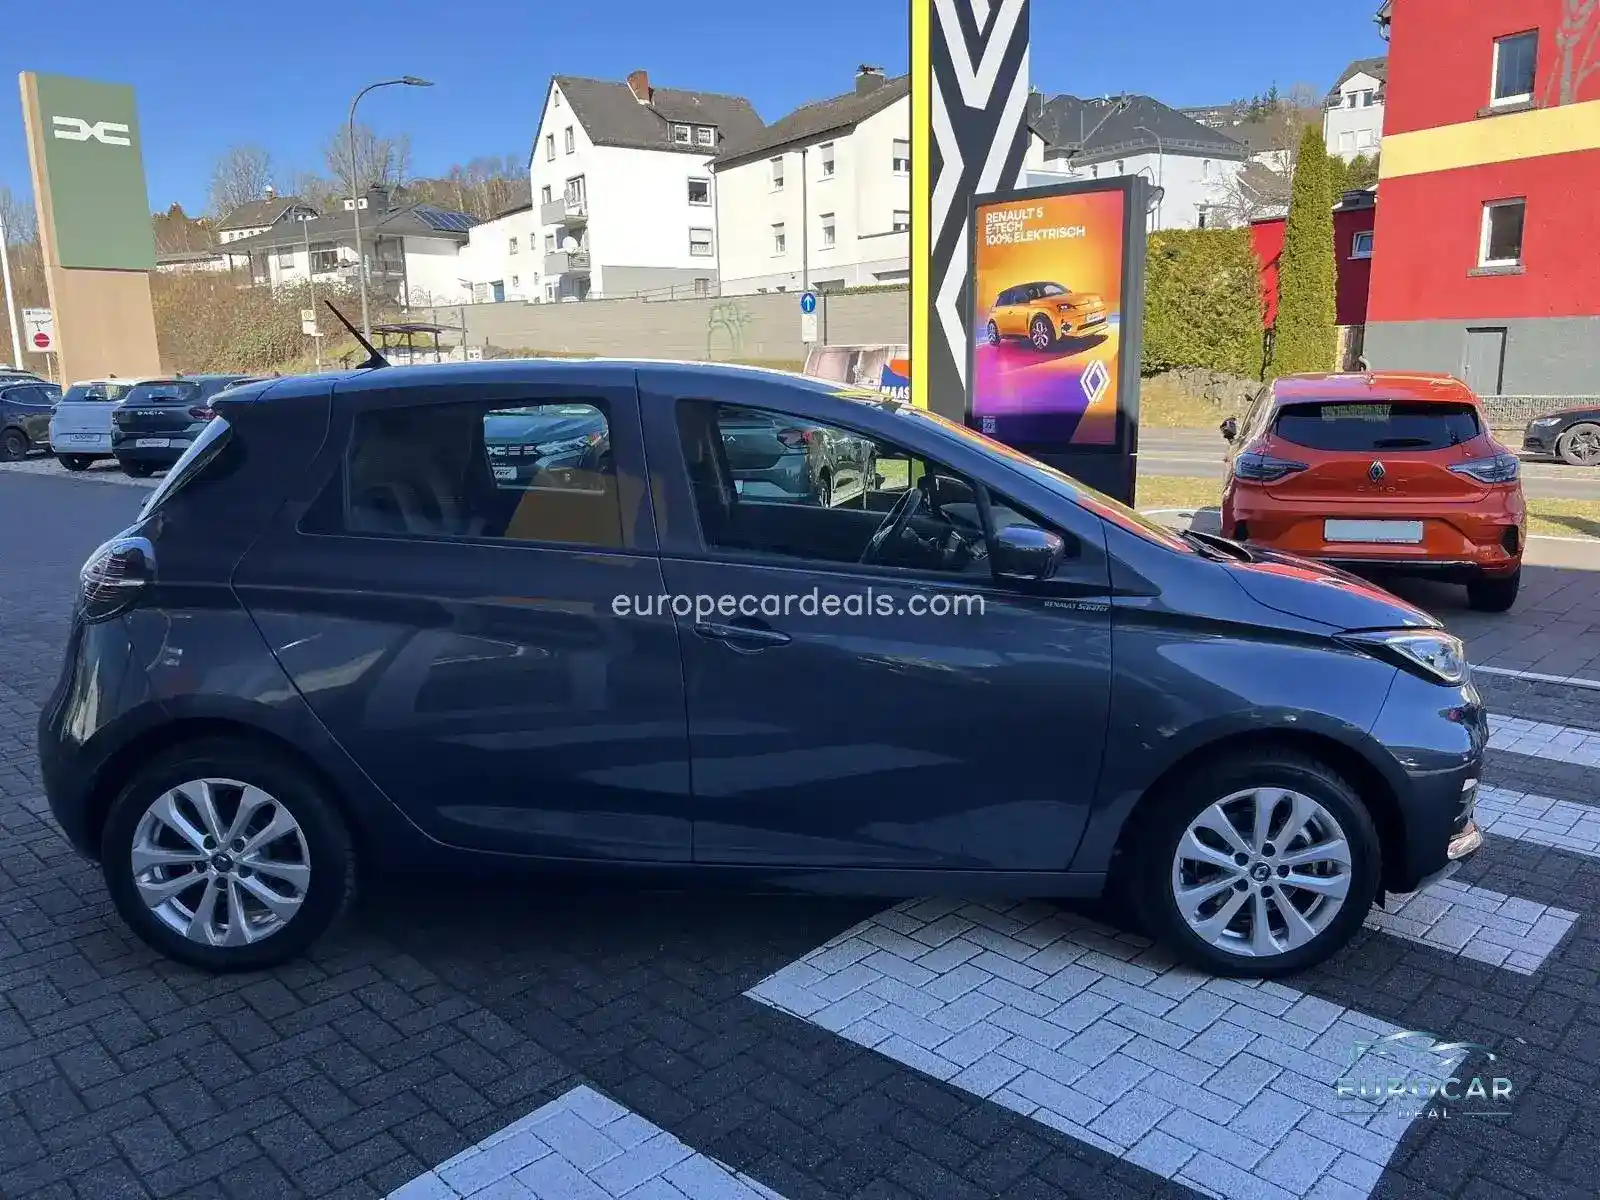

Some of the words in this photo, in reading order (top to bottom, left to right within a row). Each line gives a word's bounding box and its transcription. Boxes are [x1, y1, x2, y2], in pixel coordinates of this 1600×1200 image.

[986, 208, 1034, 223] RENAULT
[986, 220, 1023, 234] E-TECH
[986, 232, 1013, 246] 100%
[1014, 226, 1086, 243] ELEKTRISCH
[1044, 601, 1076, 609] RENAULT
